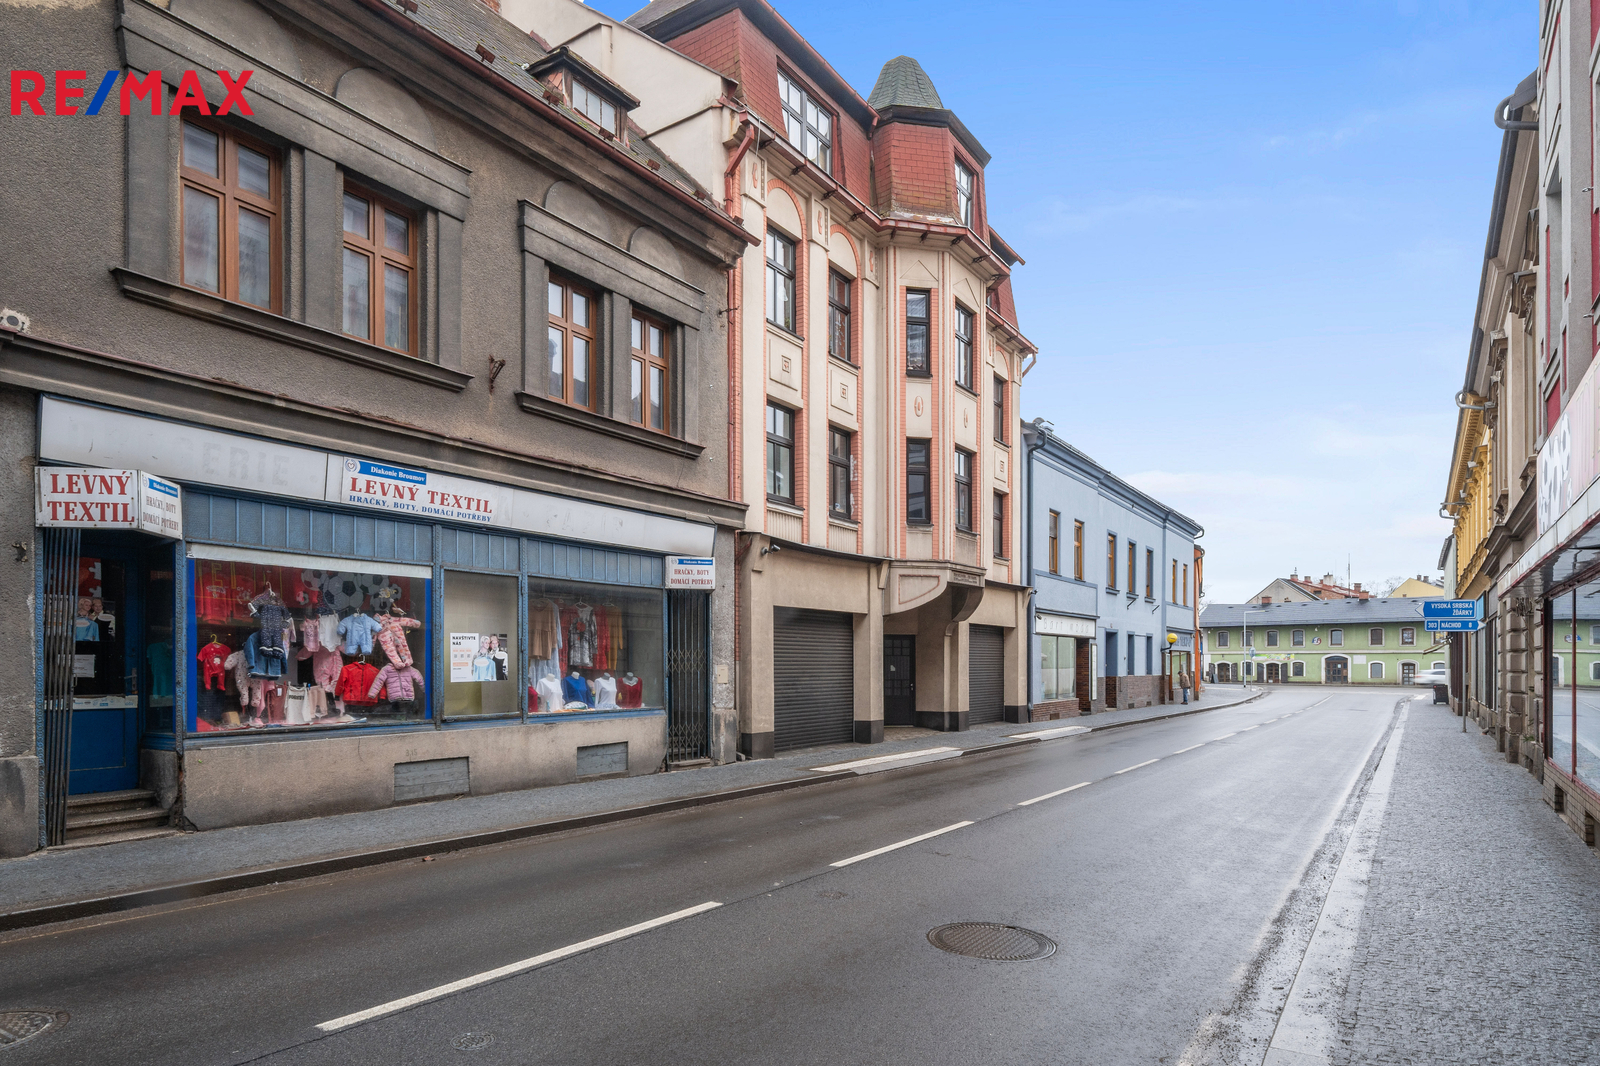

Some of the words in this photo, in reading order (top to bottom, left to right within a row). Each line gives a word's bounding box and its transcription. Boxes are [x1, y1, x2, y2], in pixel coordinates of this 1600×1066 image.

[50, 470, 130, 496] LEVNÝ
[370, 466, 397, 478] Diakonie
[398, 471, 425, 482] Broumov
[350, 477, 419, 501] LEVNÝ
[427, 490, 492, 513] TEXTIL
[47, 501, 135, 523] TEXTIL
[166, 502, 177, 514] BOTY
[349, 495, 390, 508] HRAČKY,
[393, 502, 419, 512] BOTY,
[421, 506, 454, 517] DOMÁCÍ
[456, 511, 492, 522] POTŘEBY
